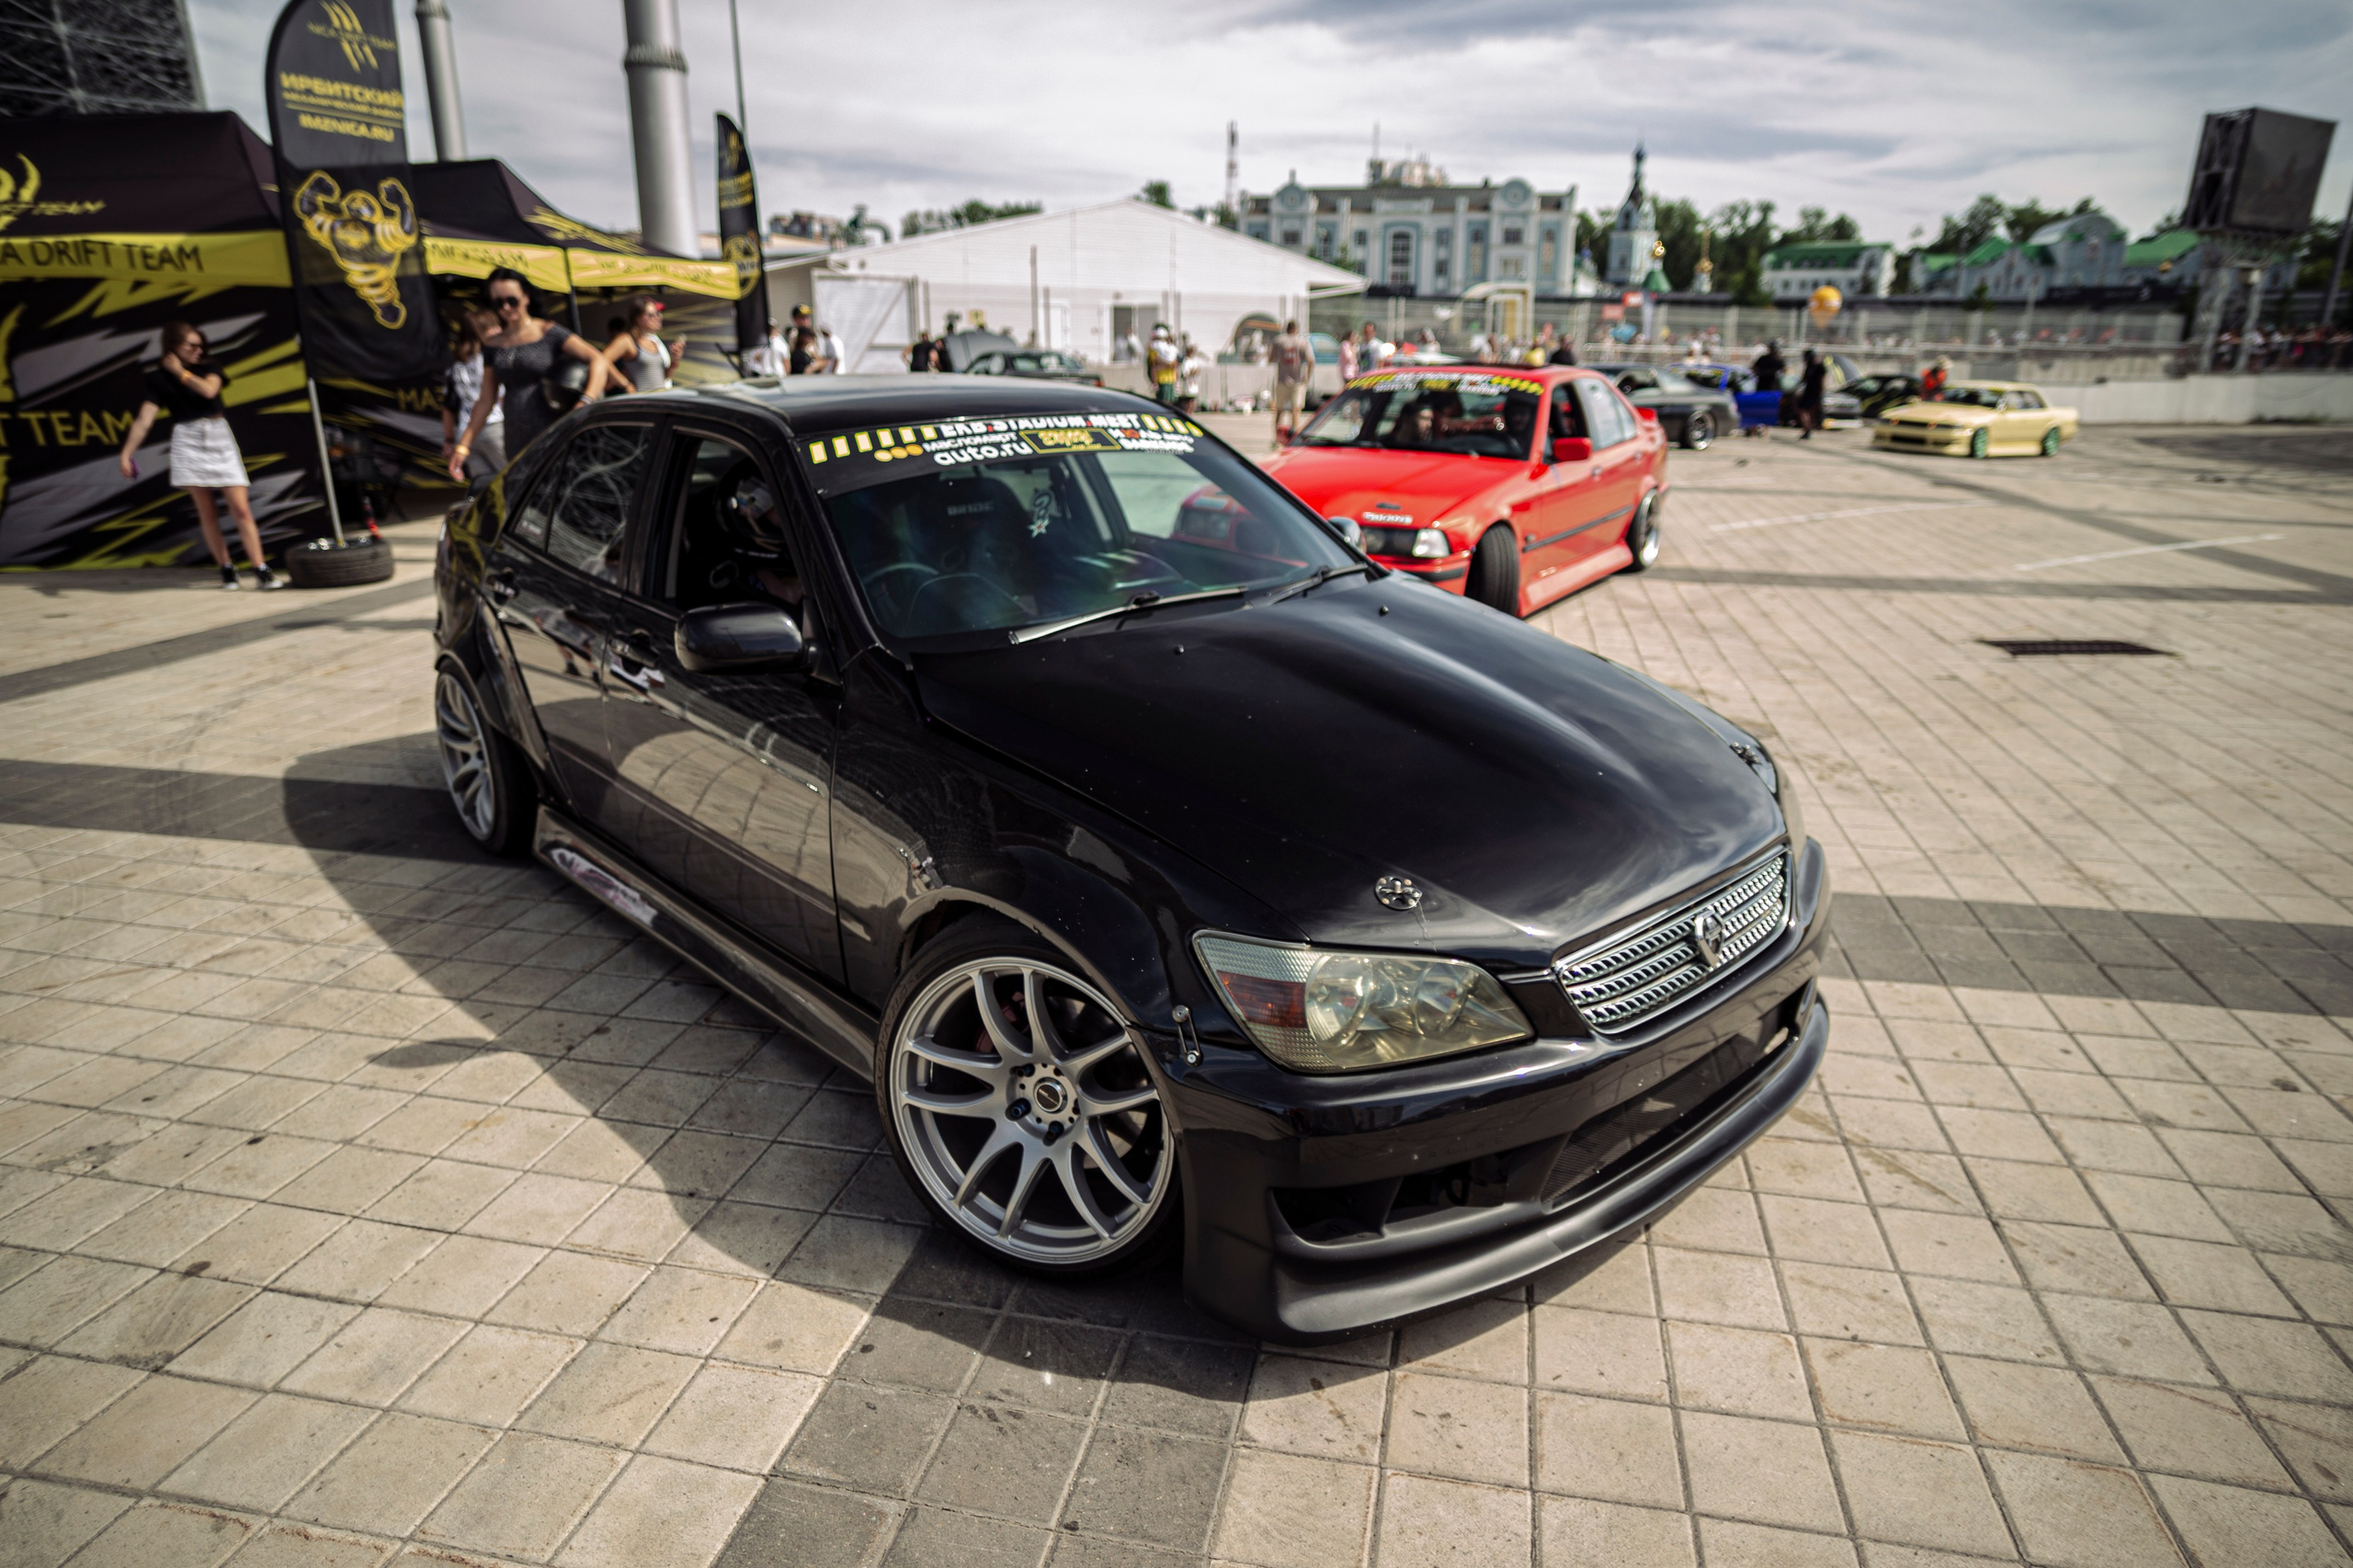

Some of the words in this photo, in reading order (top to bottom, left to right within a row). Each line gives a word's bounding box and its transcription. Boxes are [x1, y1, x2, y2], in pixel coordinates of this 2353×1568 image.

[278, 73, 404, 108] ИРБИТСКИЙ
[29, 240, 113, 267] DRIFT
[119, 242, 204, 273] TEAM
[17, 410, 134, 447] TEAM
[933, 441, 1034, 466] auto.ru
